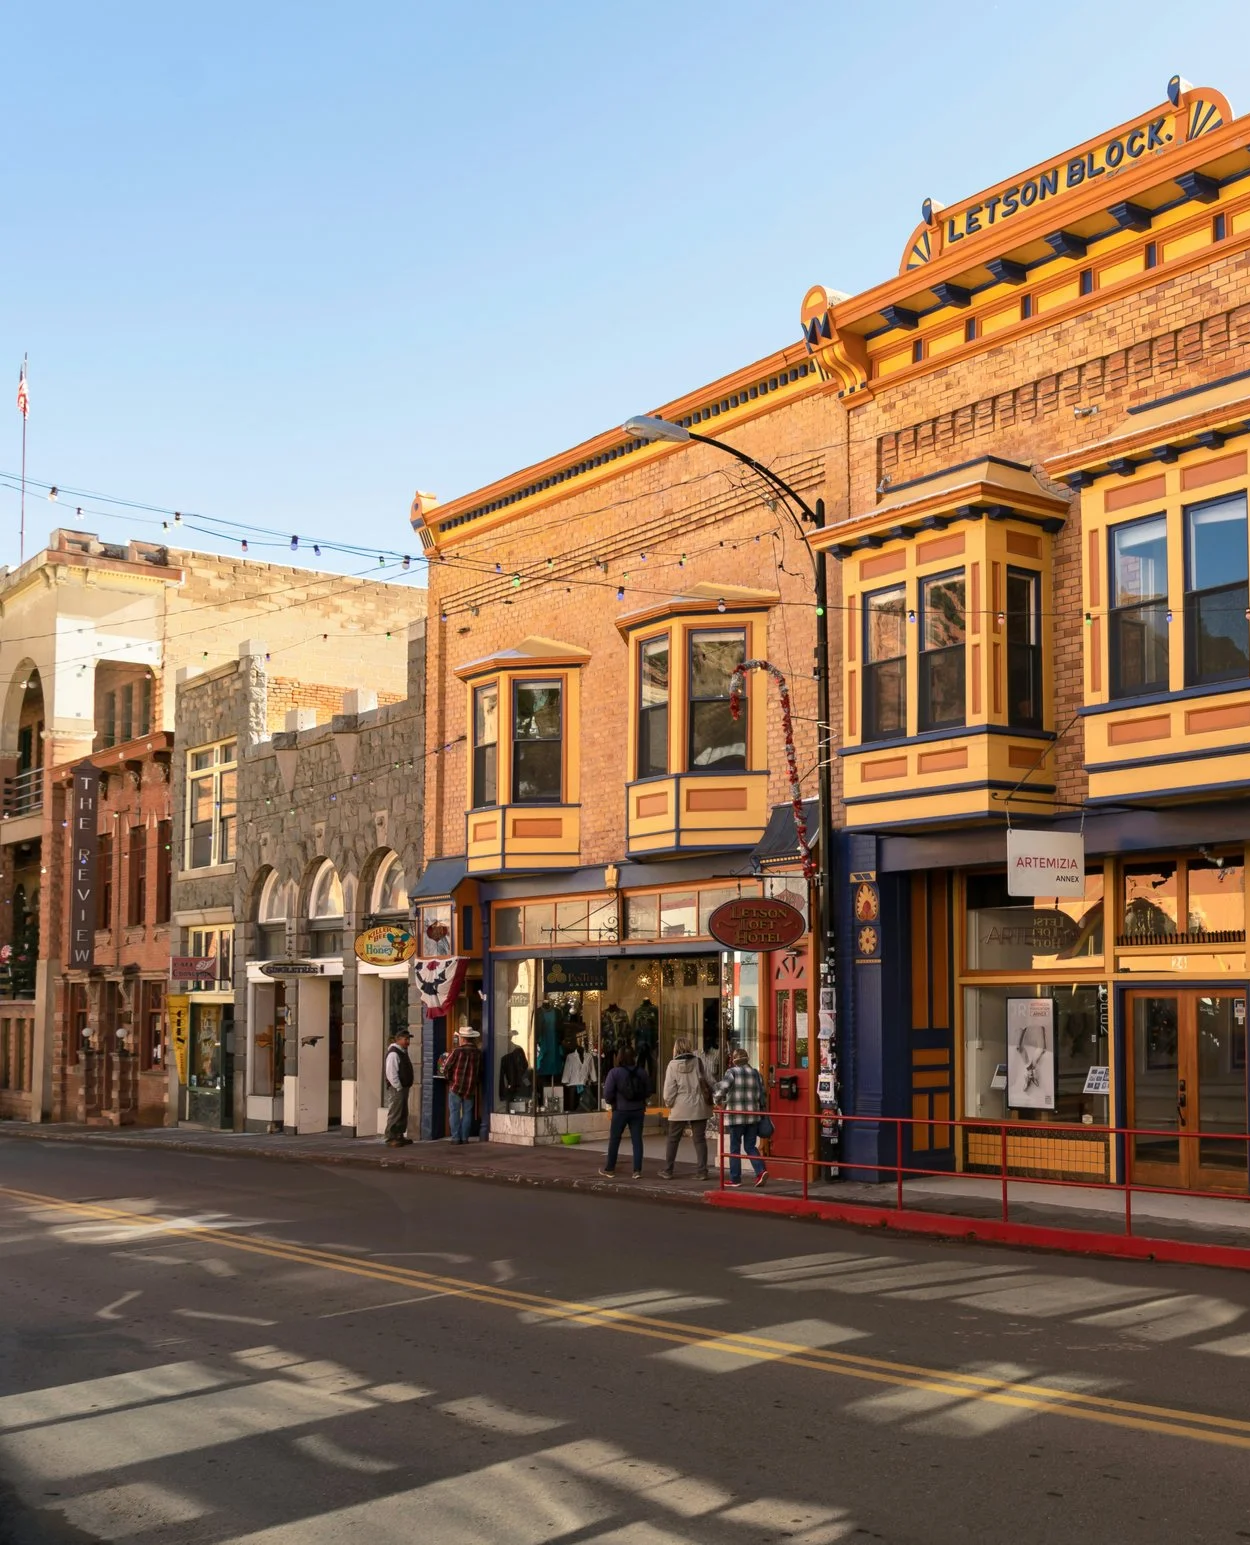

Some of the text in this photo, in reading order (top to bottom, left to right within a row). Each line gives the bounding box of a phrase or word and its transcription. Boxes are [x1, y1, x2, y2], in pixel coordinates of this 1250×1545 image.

[948, 169, 1059, 243] LETSON
[75, 777, 93, 962] THE REVIEW
[1016, 857, 1079, 869] ARTEMIZIA
[1056, 875, 1080, 883] ANNEX
[731, 906, 787, 920] LETSON
[739, 918, 777, 932] LOFT
[366, 927, 393, 941] KILLER
[734, 930, 784, 945] HOTEL
[366, 944, 394, 957] Honey
[1172, 956, 1187, 969] 24
